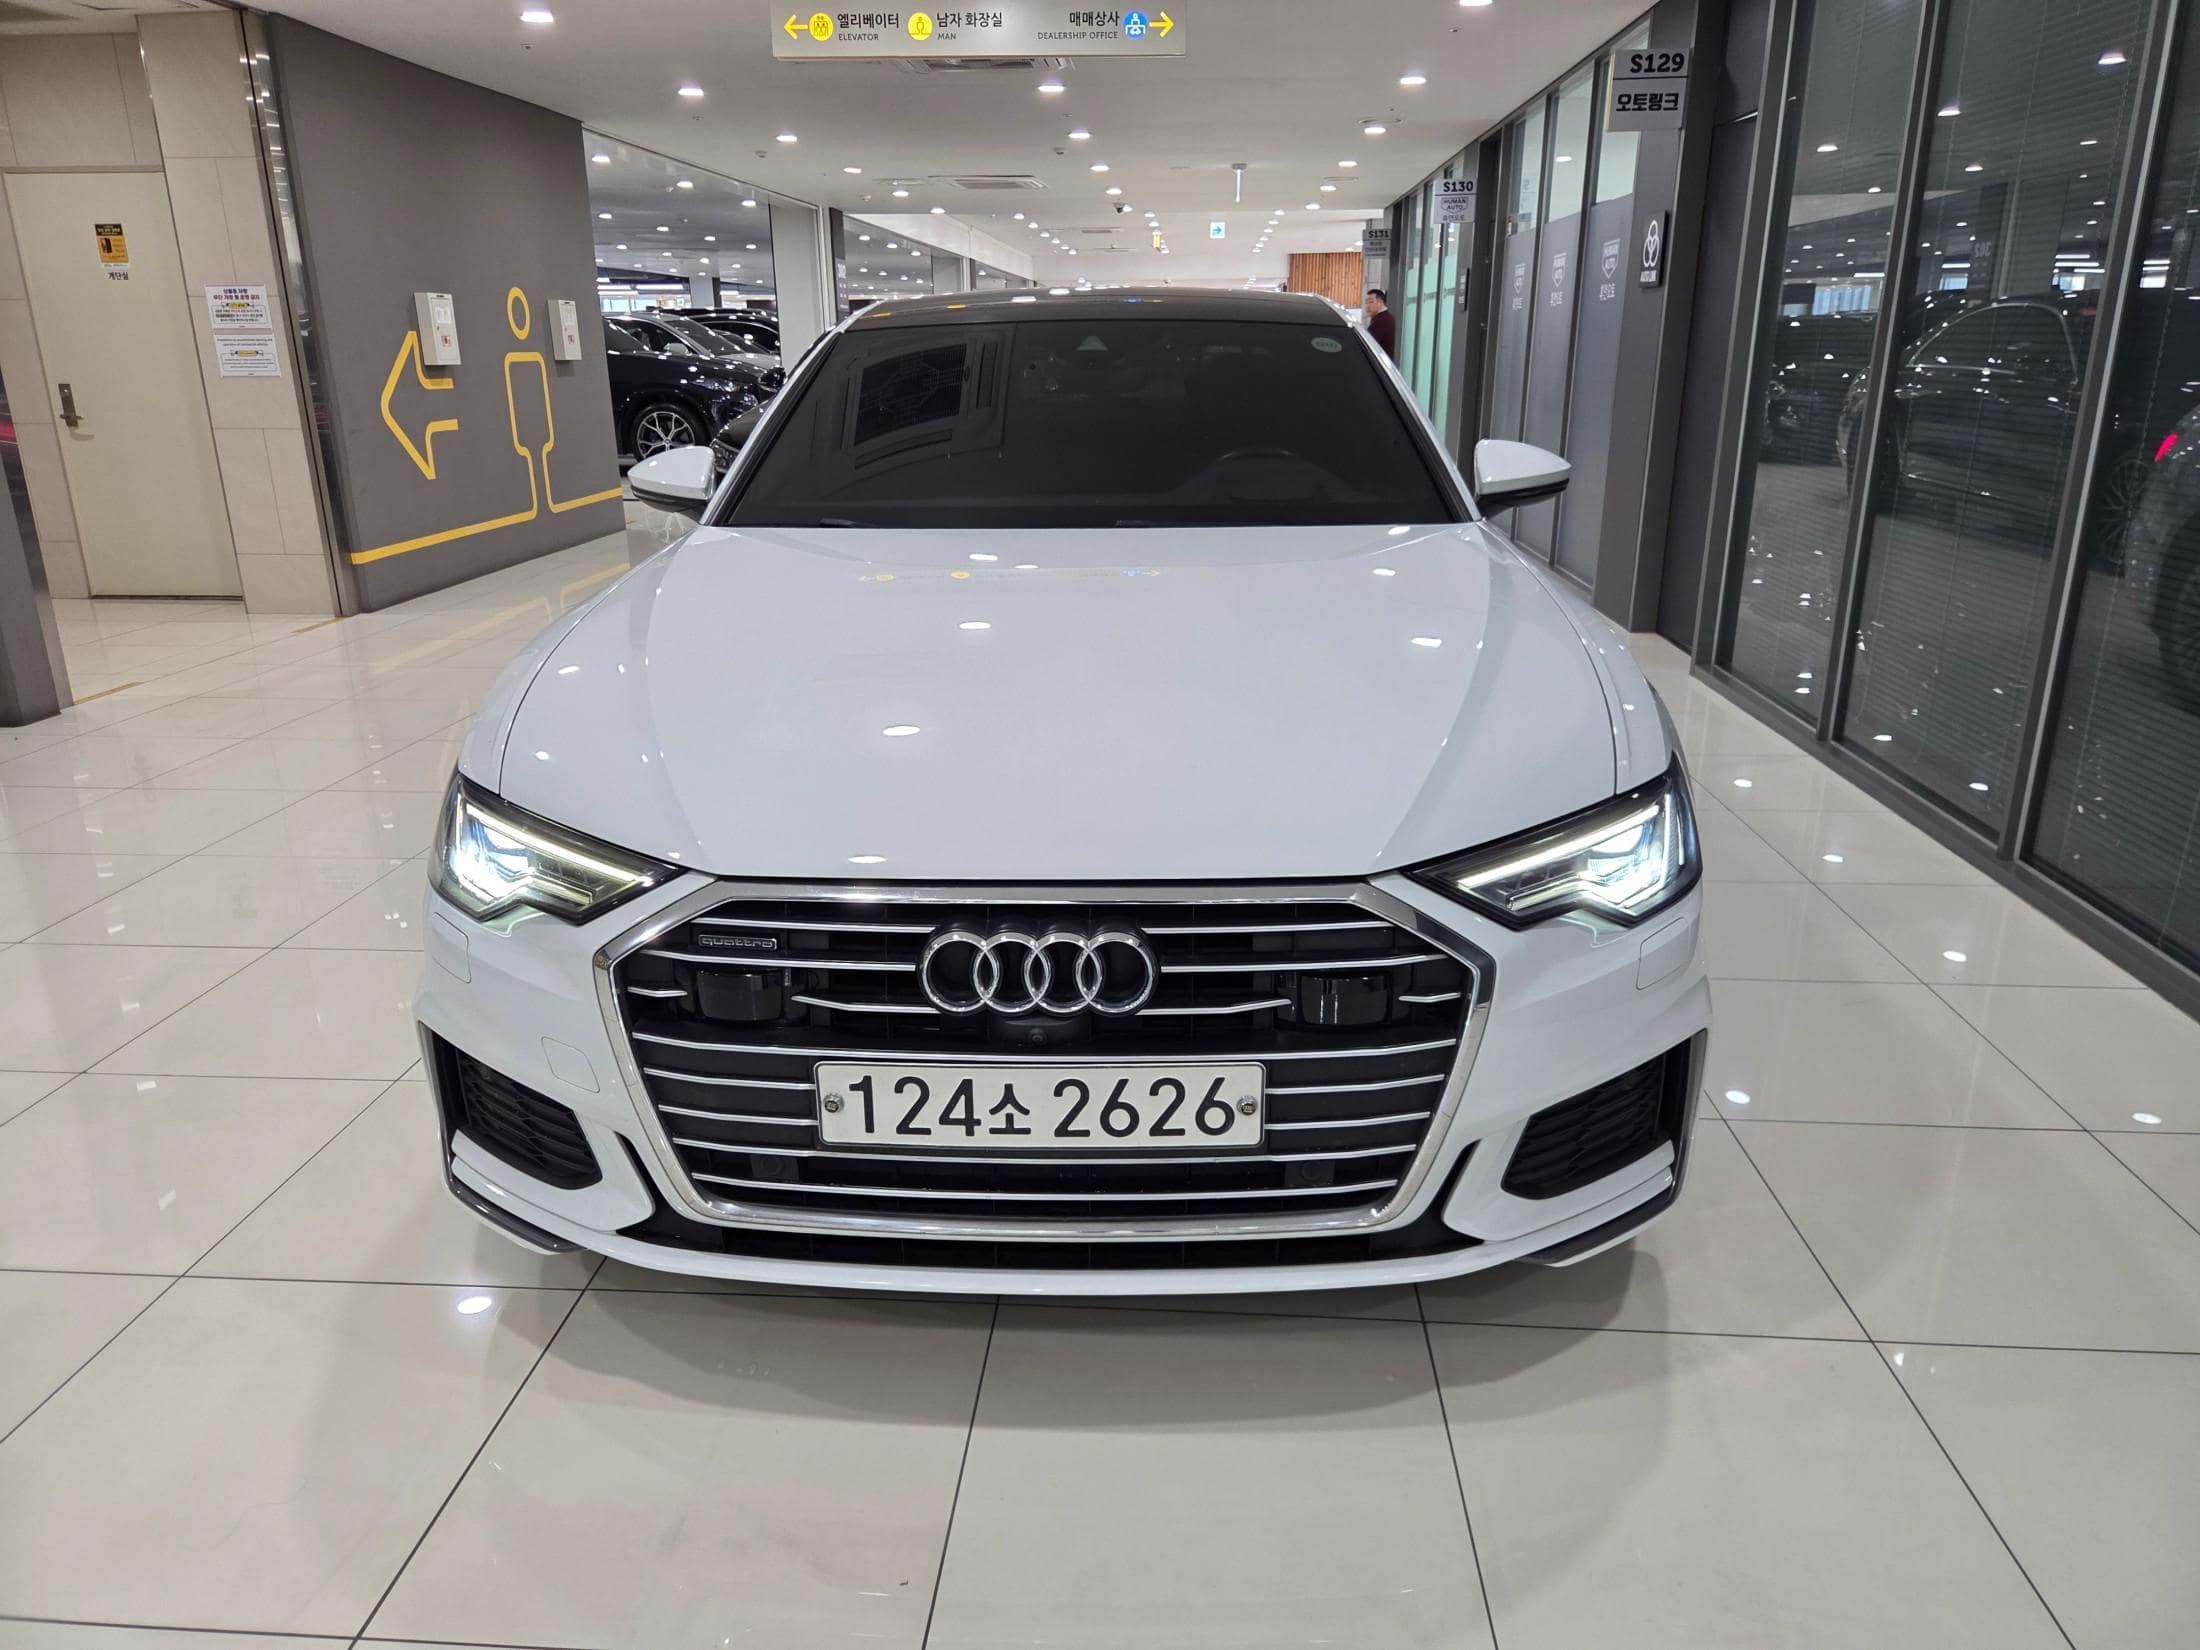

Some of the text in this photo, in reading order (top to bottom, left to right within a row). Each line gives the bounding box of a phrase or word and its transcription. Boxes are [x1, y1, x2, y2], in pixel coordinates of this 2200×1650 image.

[837, 13, 899, 29] 엘리베이터
[936, 12, 1003, 28] 남자 화장실
[1069, 11, 1121, 27] 매매상사
[838, 33, 879, 41] ELEVATOR
[938, 32, 957, 41] MAN
[1037, 31, 1119, 40] DEALERSHIP OFFICE
[1630, 52, 1685, 74] S129
[1616, 93, 1679, 111] 오토링크
[1443, 180, 1474, 193] S130
[1368, 230, 1389, 239] S131
[108, 271, 129, 281] 계단실
[701, 937, 774, 949] quattro
[848, 1074, 1237, 1138] 124소 2626
